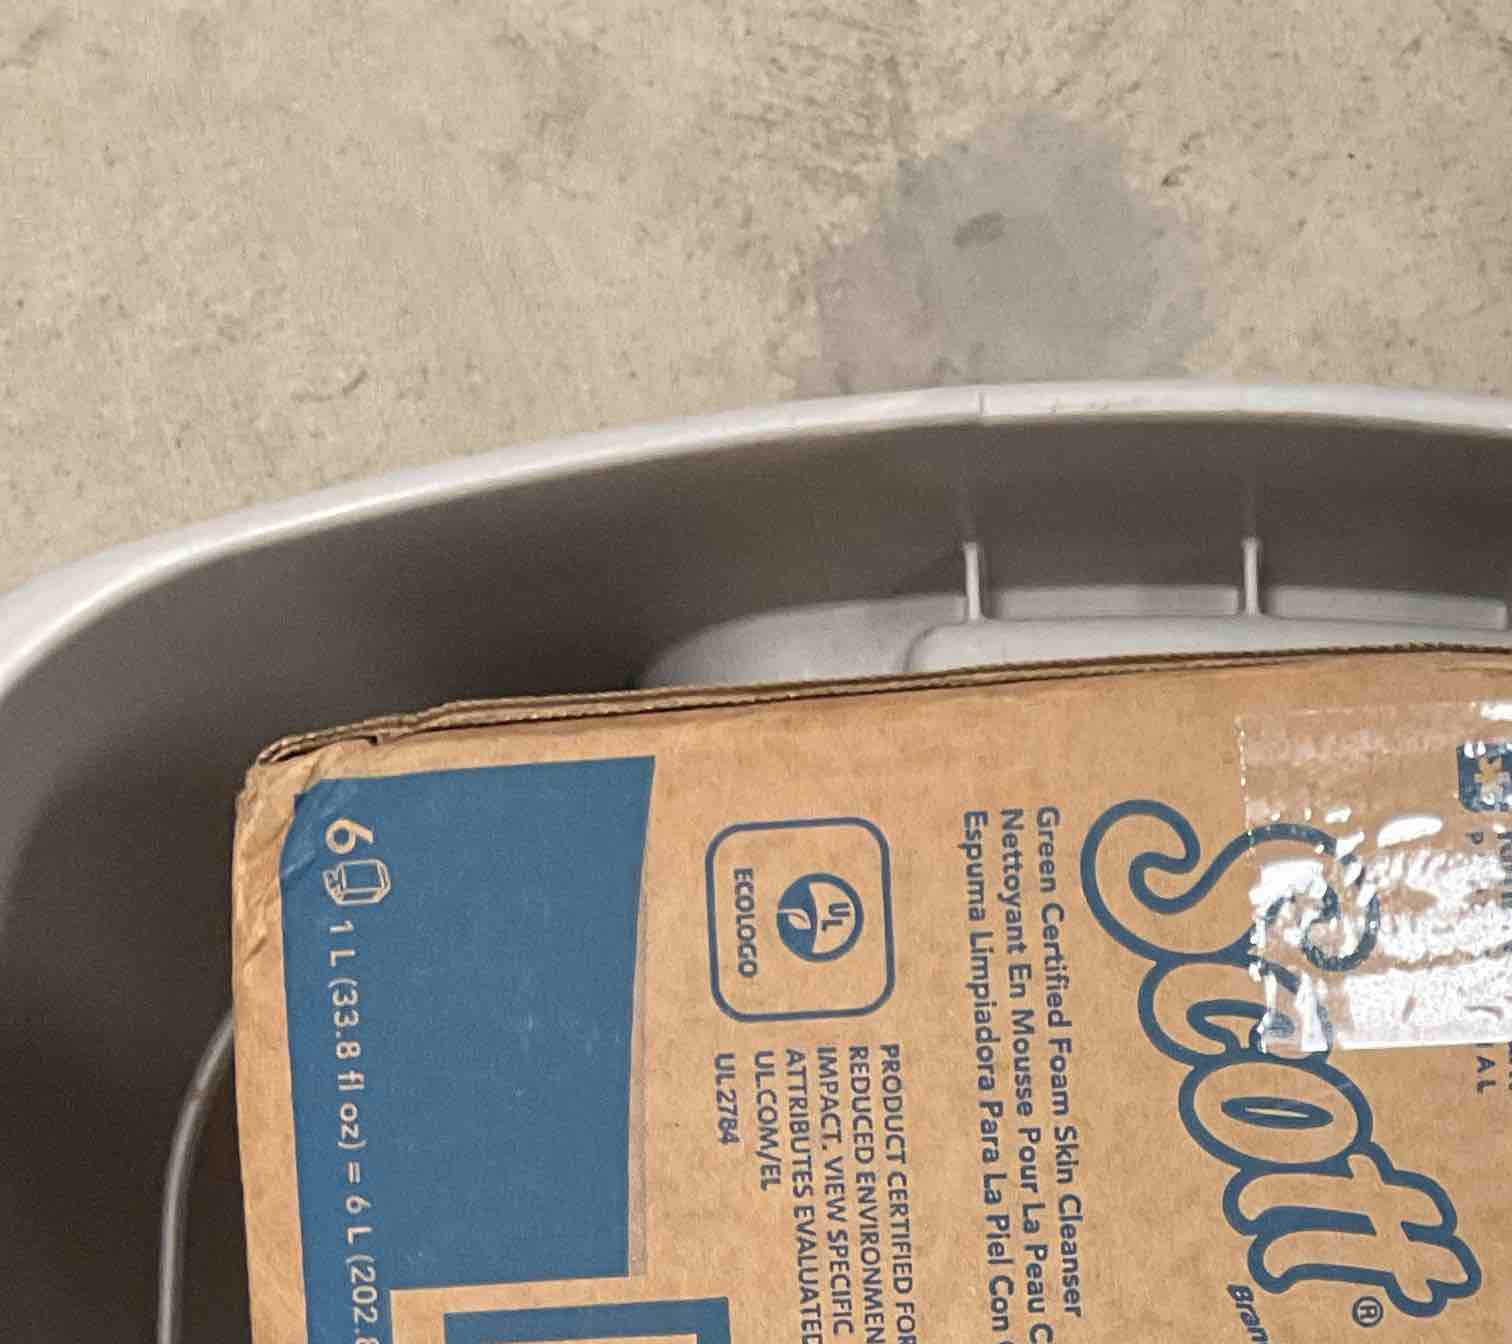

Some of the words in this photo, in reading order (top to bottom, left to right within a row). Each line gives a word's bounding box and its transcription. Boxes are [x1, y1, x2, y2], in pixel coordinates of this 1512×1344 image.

[325, 819, 374, 854] 6
[959, 811, 988, 920] Espuma
[1037, 807, 1060, 892] Green
[998, 809, 1026, 954] Nettoyant
[330, 921, 353, 932] 1
[734, 868, 757, 978] ECOLOGO
[821, 902, 850, 931] UL
[330, 950, 355, 966] L
[1008, 964, 1032, 998] En
[1041, 903, 1072, 1027] Certified
[328, 977, 362, 1058] (33.8
[966, 932, 1000, 1090] Limpiadora
[337, 1071, 365, 1091] fl
[1012, 1009, 1038, 1116] Mousse
[1048, 1038, 1072, 1115] Foam
[337, 1103, 366, 1151] oz)
[786, 1048, 813, 1198] ATTRIBUTES
[817, 1046, 844, 1150] IMPACT.
[850, 1046, 875, 1163] REDUCED
[881, 1044, 906, 1163] PRODUCT
[980, 1101, 1006, 1162] Para
[1018, 1127, 1041, 1192] Pour
[1054, 1126, 1081, 1183] Skin
[346, 1196, 370, 1214] 6
[824, 1157, 847, 1222] VIEW
[984, 1173, 1007, 1205] La
[1022, 1203, 1047, 1234] La
[347, 1227, 371, 1242] L
[887, 1171, 913, 1294] CERTIFIED
[985, 1214, 1013, 1264] Piel
[1058, 1194, 1084, 1318] Cleanser
[828, 1230, 853, 1335] SPECIFIC
[988, 1275, 1015, 1330] Con
[1025, 1244, 1048, 1312] Peau
